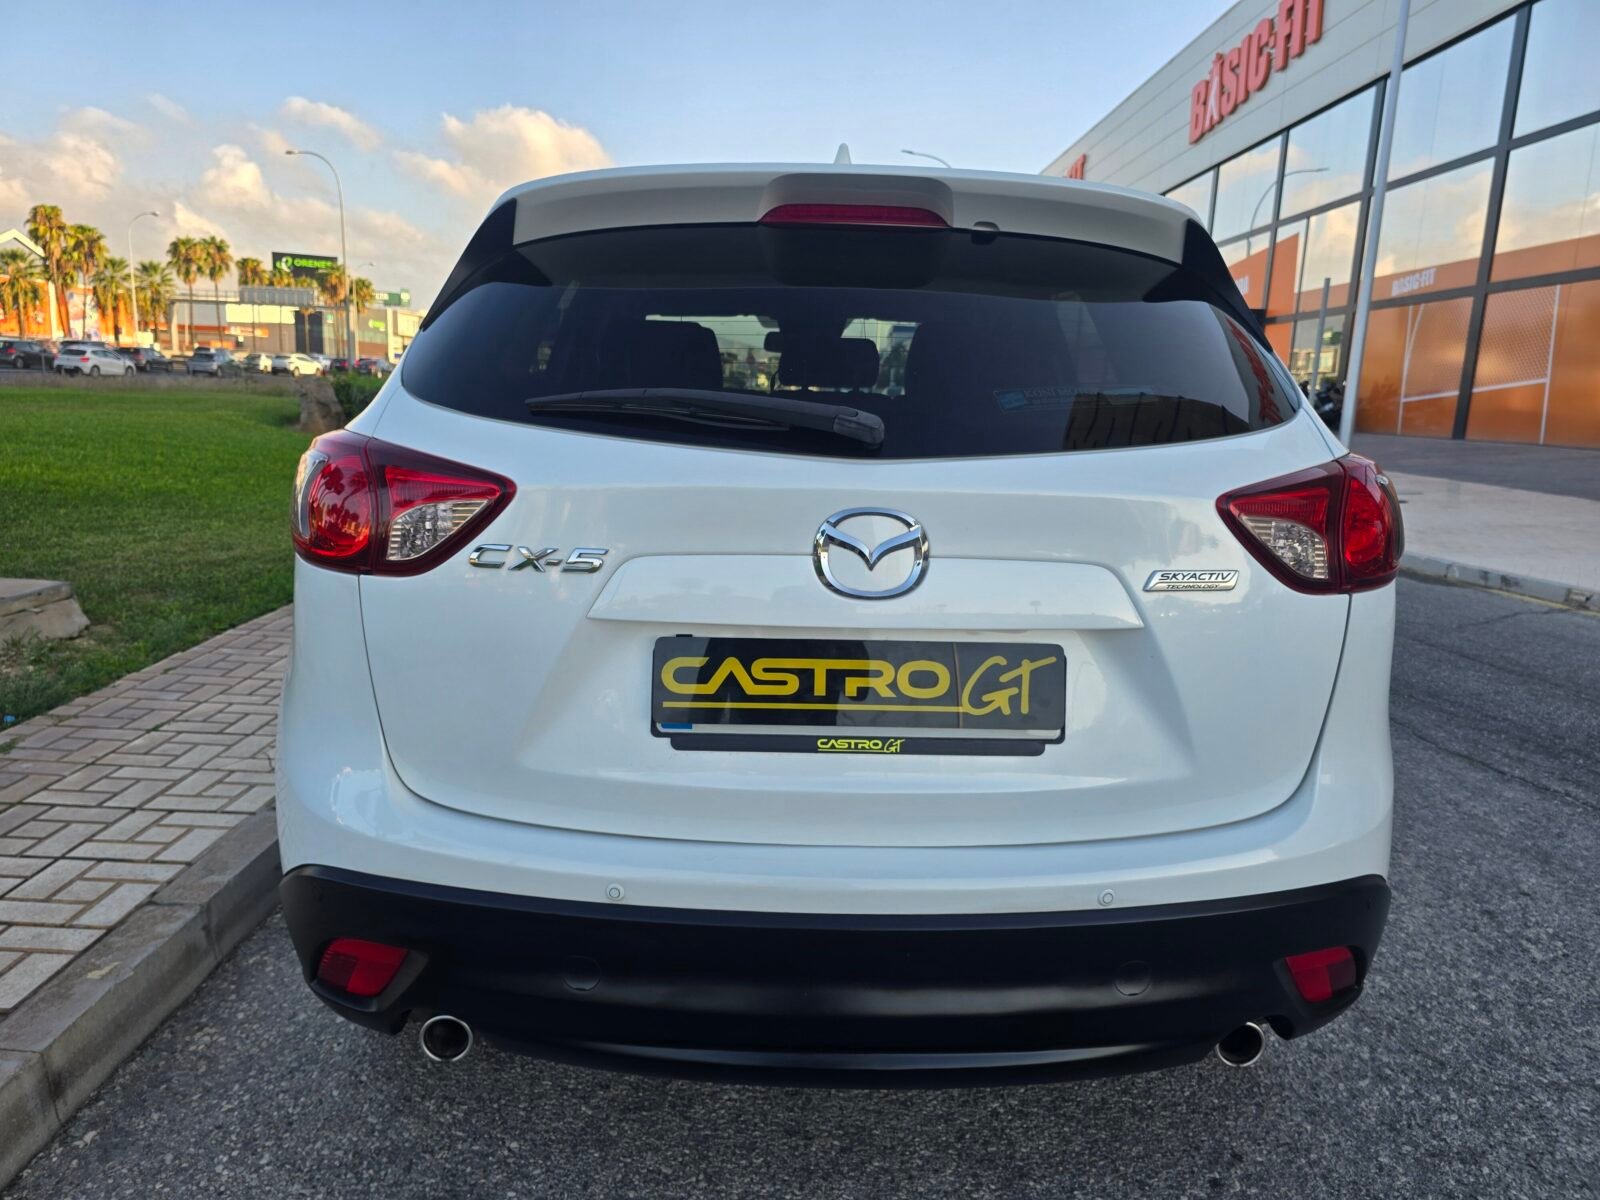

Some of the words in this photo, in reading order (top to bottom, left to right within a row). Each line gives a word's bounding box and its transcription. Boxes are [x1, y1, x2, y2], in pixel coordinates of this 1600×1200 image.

[468, 543, 609, 574] CX-5
[1158, 572, 1232, 581] SKYACTIV
[661, 656, 951, 699] CASTRO
[961, 656, 1057, 715] GT
[816, 738, 883, 750] CASTRO
[883, 738, 906, 753] GT
